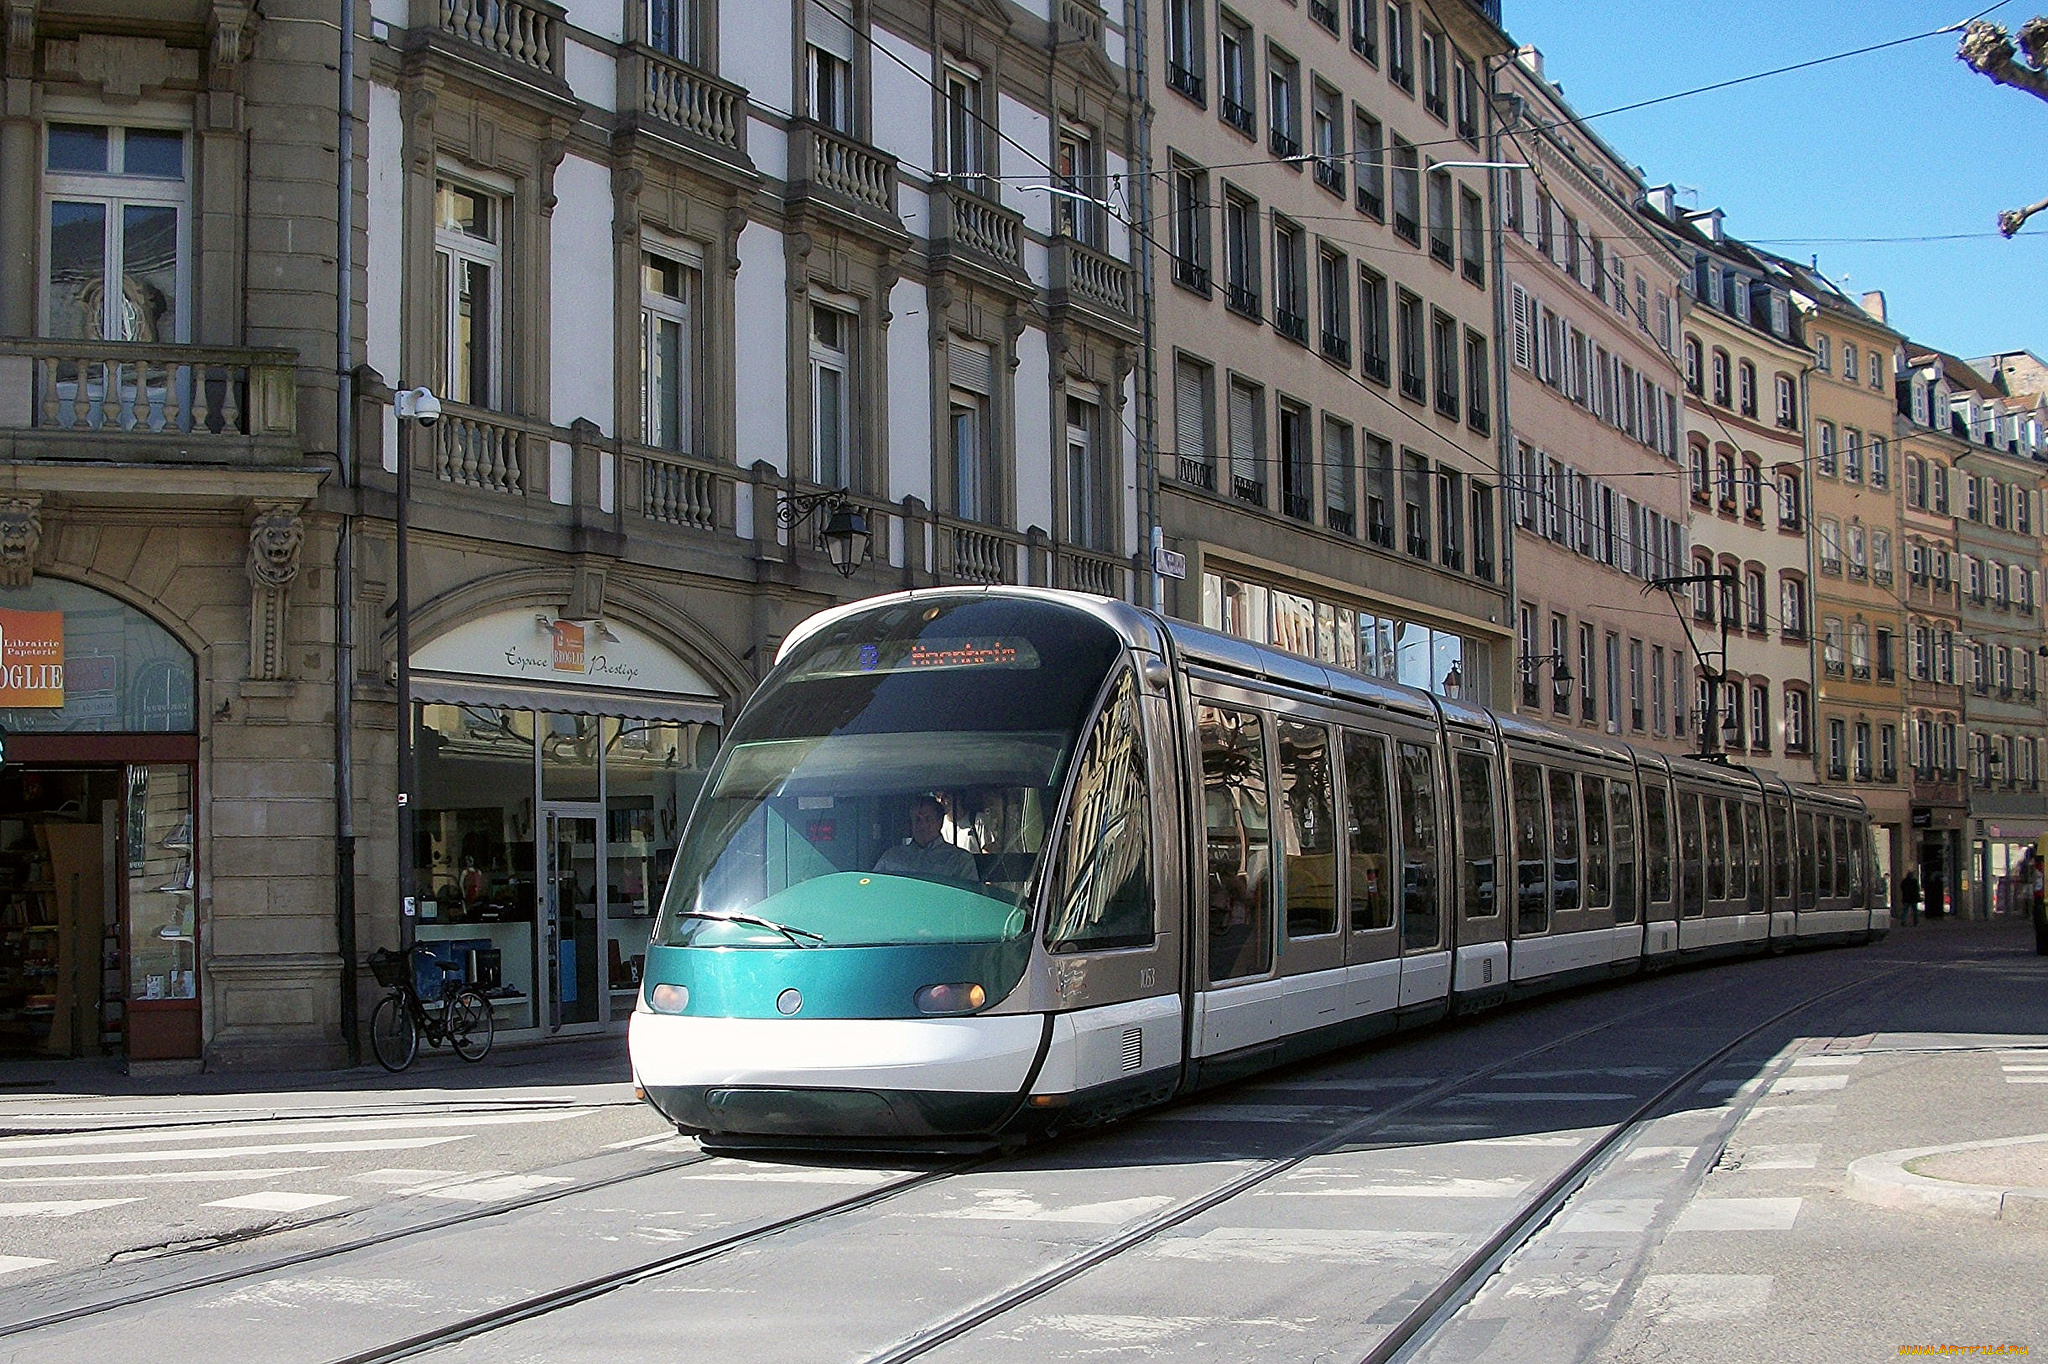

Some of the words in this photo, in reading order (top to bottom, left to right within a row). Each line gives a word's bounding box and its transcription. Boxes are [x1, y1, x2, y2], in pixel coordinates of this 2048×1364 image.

[4, 639, 60, 648] Librairie
[6, 648, 58, 657] Papeterie
[505, 646, 548, 671] Espace
[588, 655, 639, 681] Prestige
